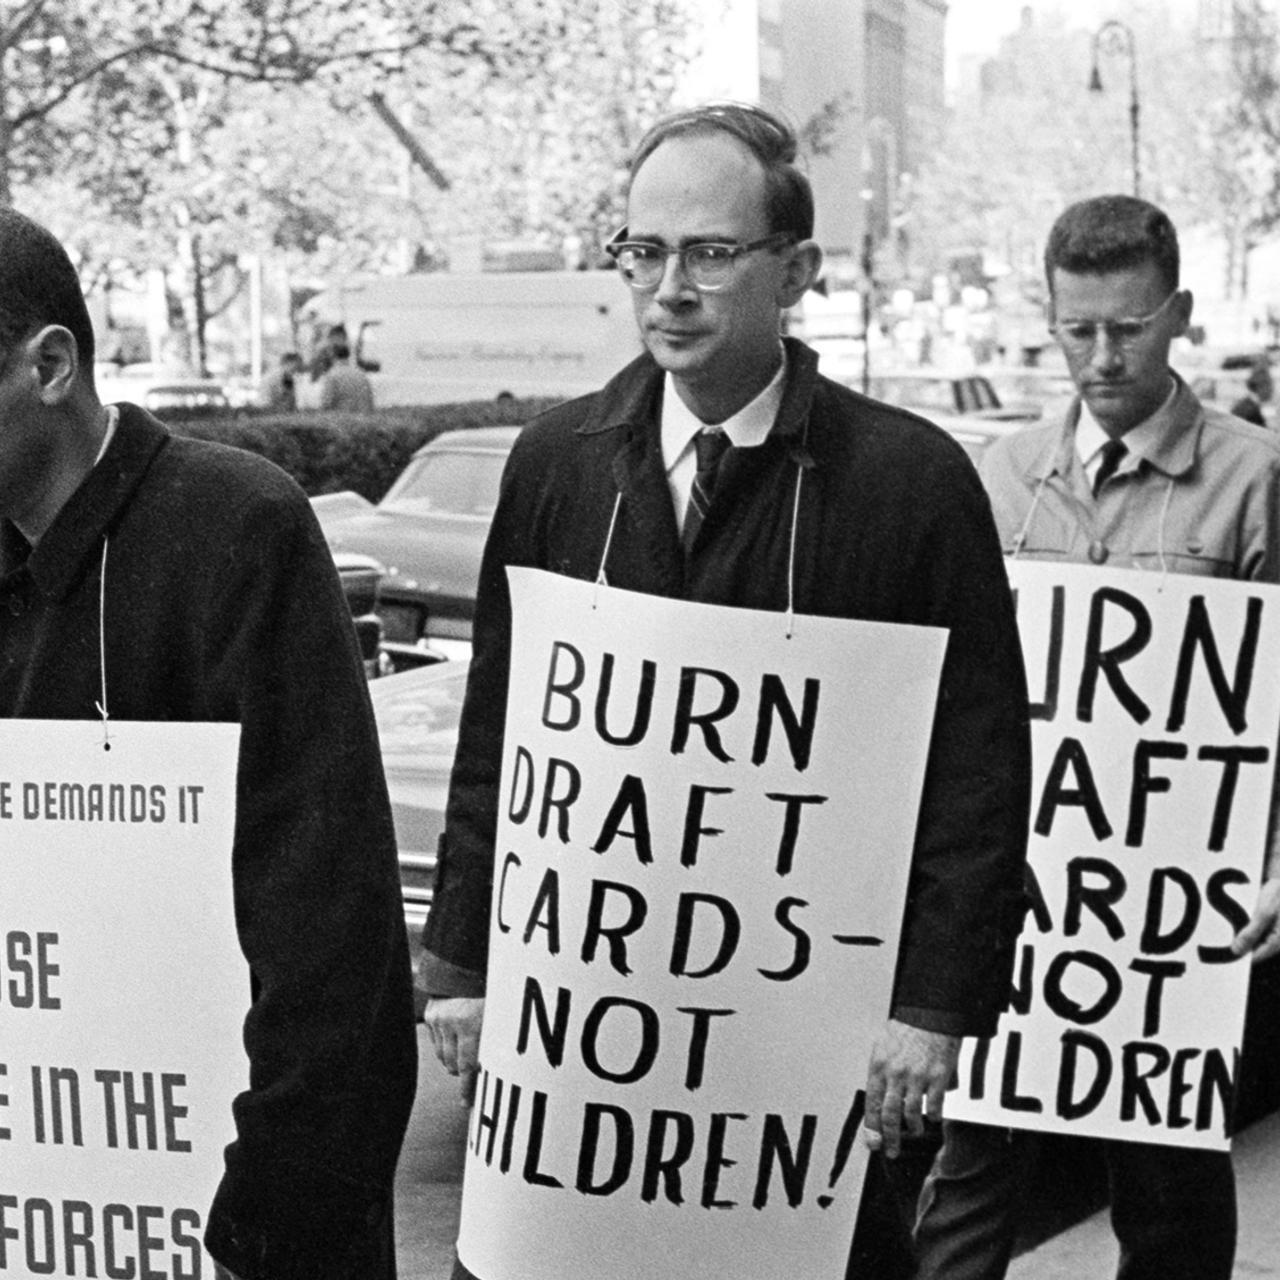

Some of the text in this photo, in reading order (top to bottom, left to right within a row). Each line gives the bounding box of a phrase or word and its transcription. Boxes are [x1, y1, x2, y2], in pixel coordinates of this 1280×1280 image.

[542, 641, 821, 773] BURN
[23, 780, 166, 824] DEMANDS
[177, 784, 205, 824] IT
[508, 745, 829, 877] DRAFT
[1033, 737, 1270, 852] AFT
[517, 976, 738, 1092] NOT
[32, 1064, 82, 1147] IN
[94, 1068, 193, 1153] THE
[469, 1069, 868, 1211] HILDREN!
